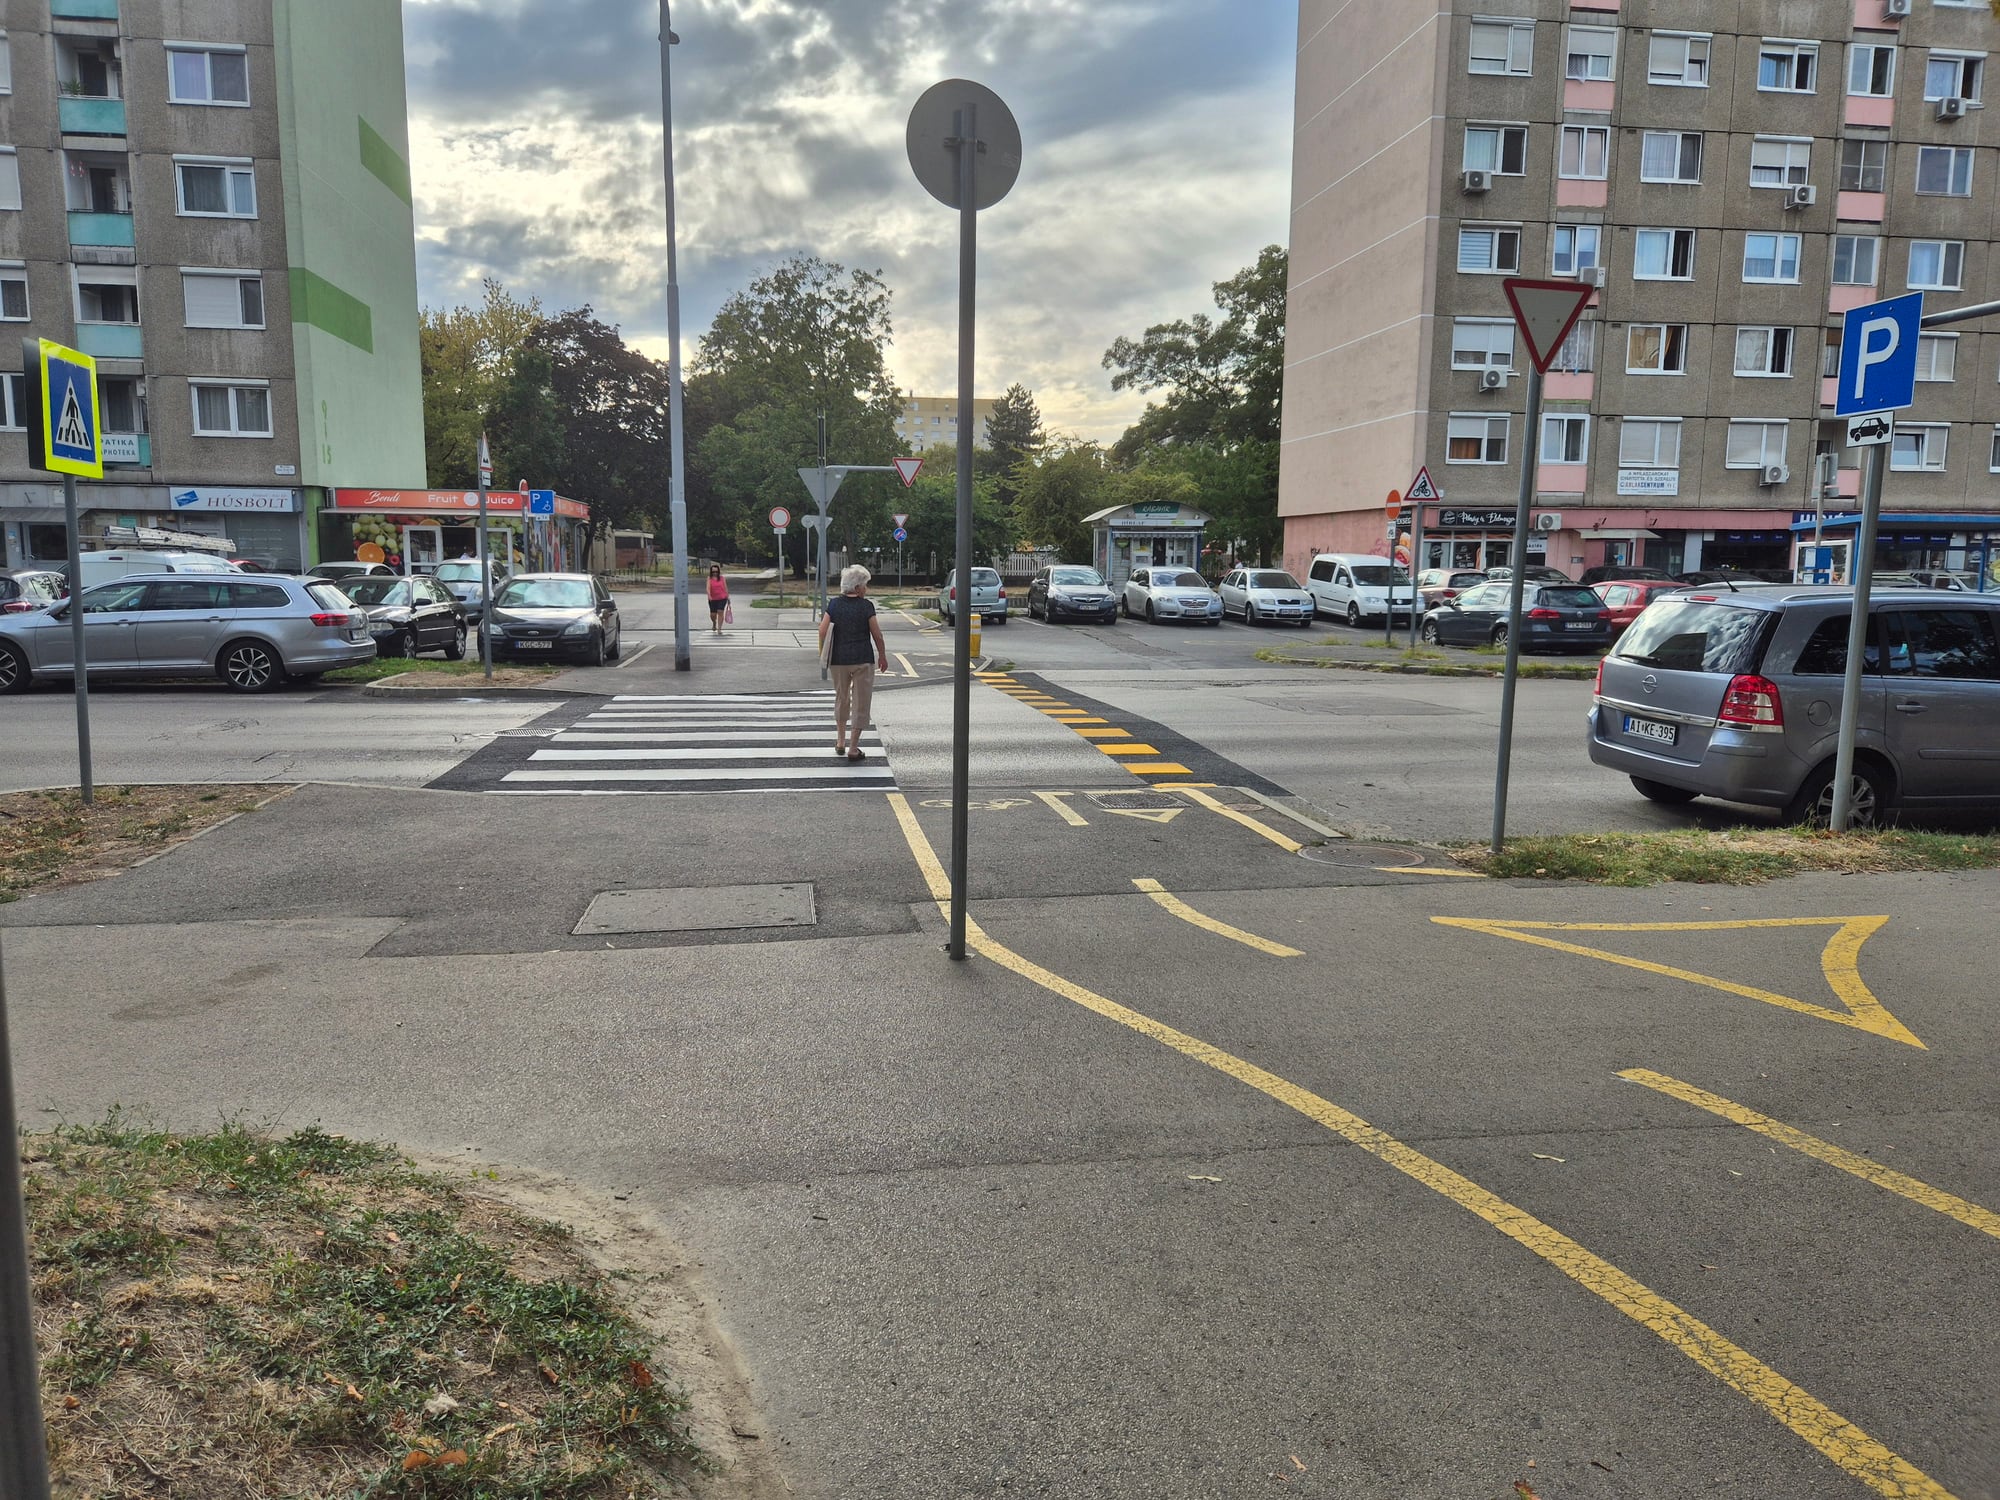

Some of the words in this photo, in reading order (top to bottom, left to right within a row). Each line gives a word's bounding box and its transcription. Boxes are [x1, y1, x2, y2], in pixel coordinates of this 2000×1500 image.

[1854, 316, 1900, 400] P
[207, 494, 288, 509] HÚSBOLT
[428, 494, 459, 504] Fruit
[485, 494, 515, 505] Juice
[532, 493, 540, 504] P
